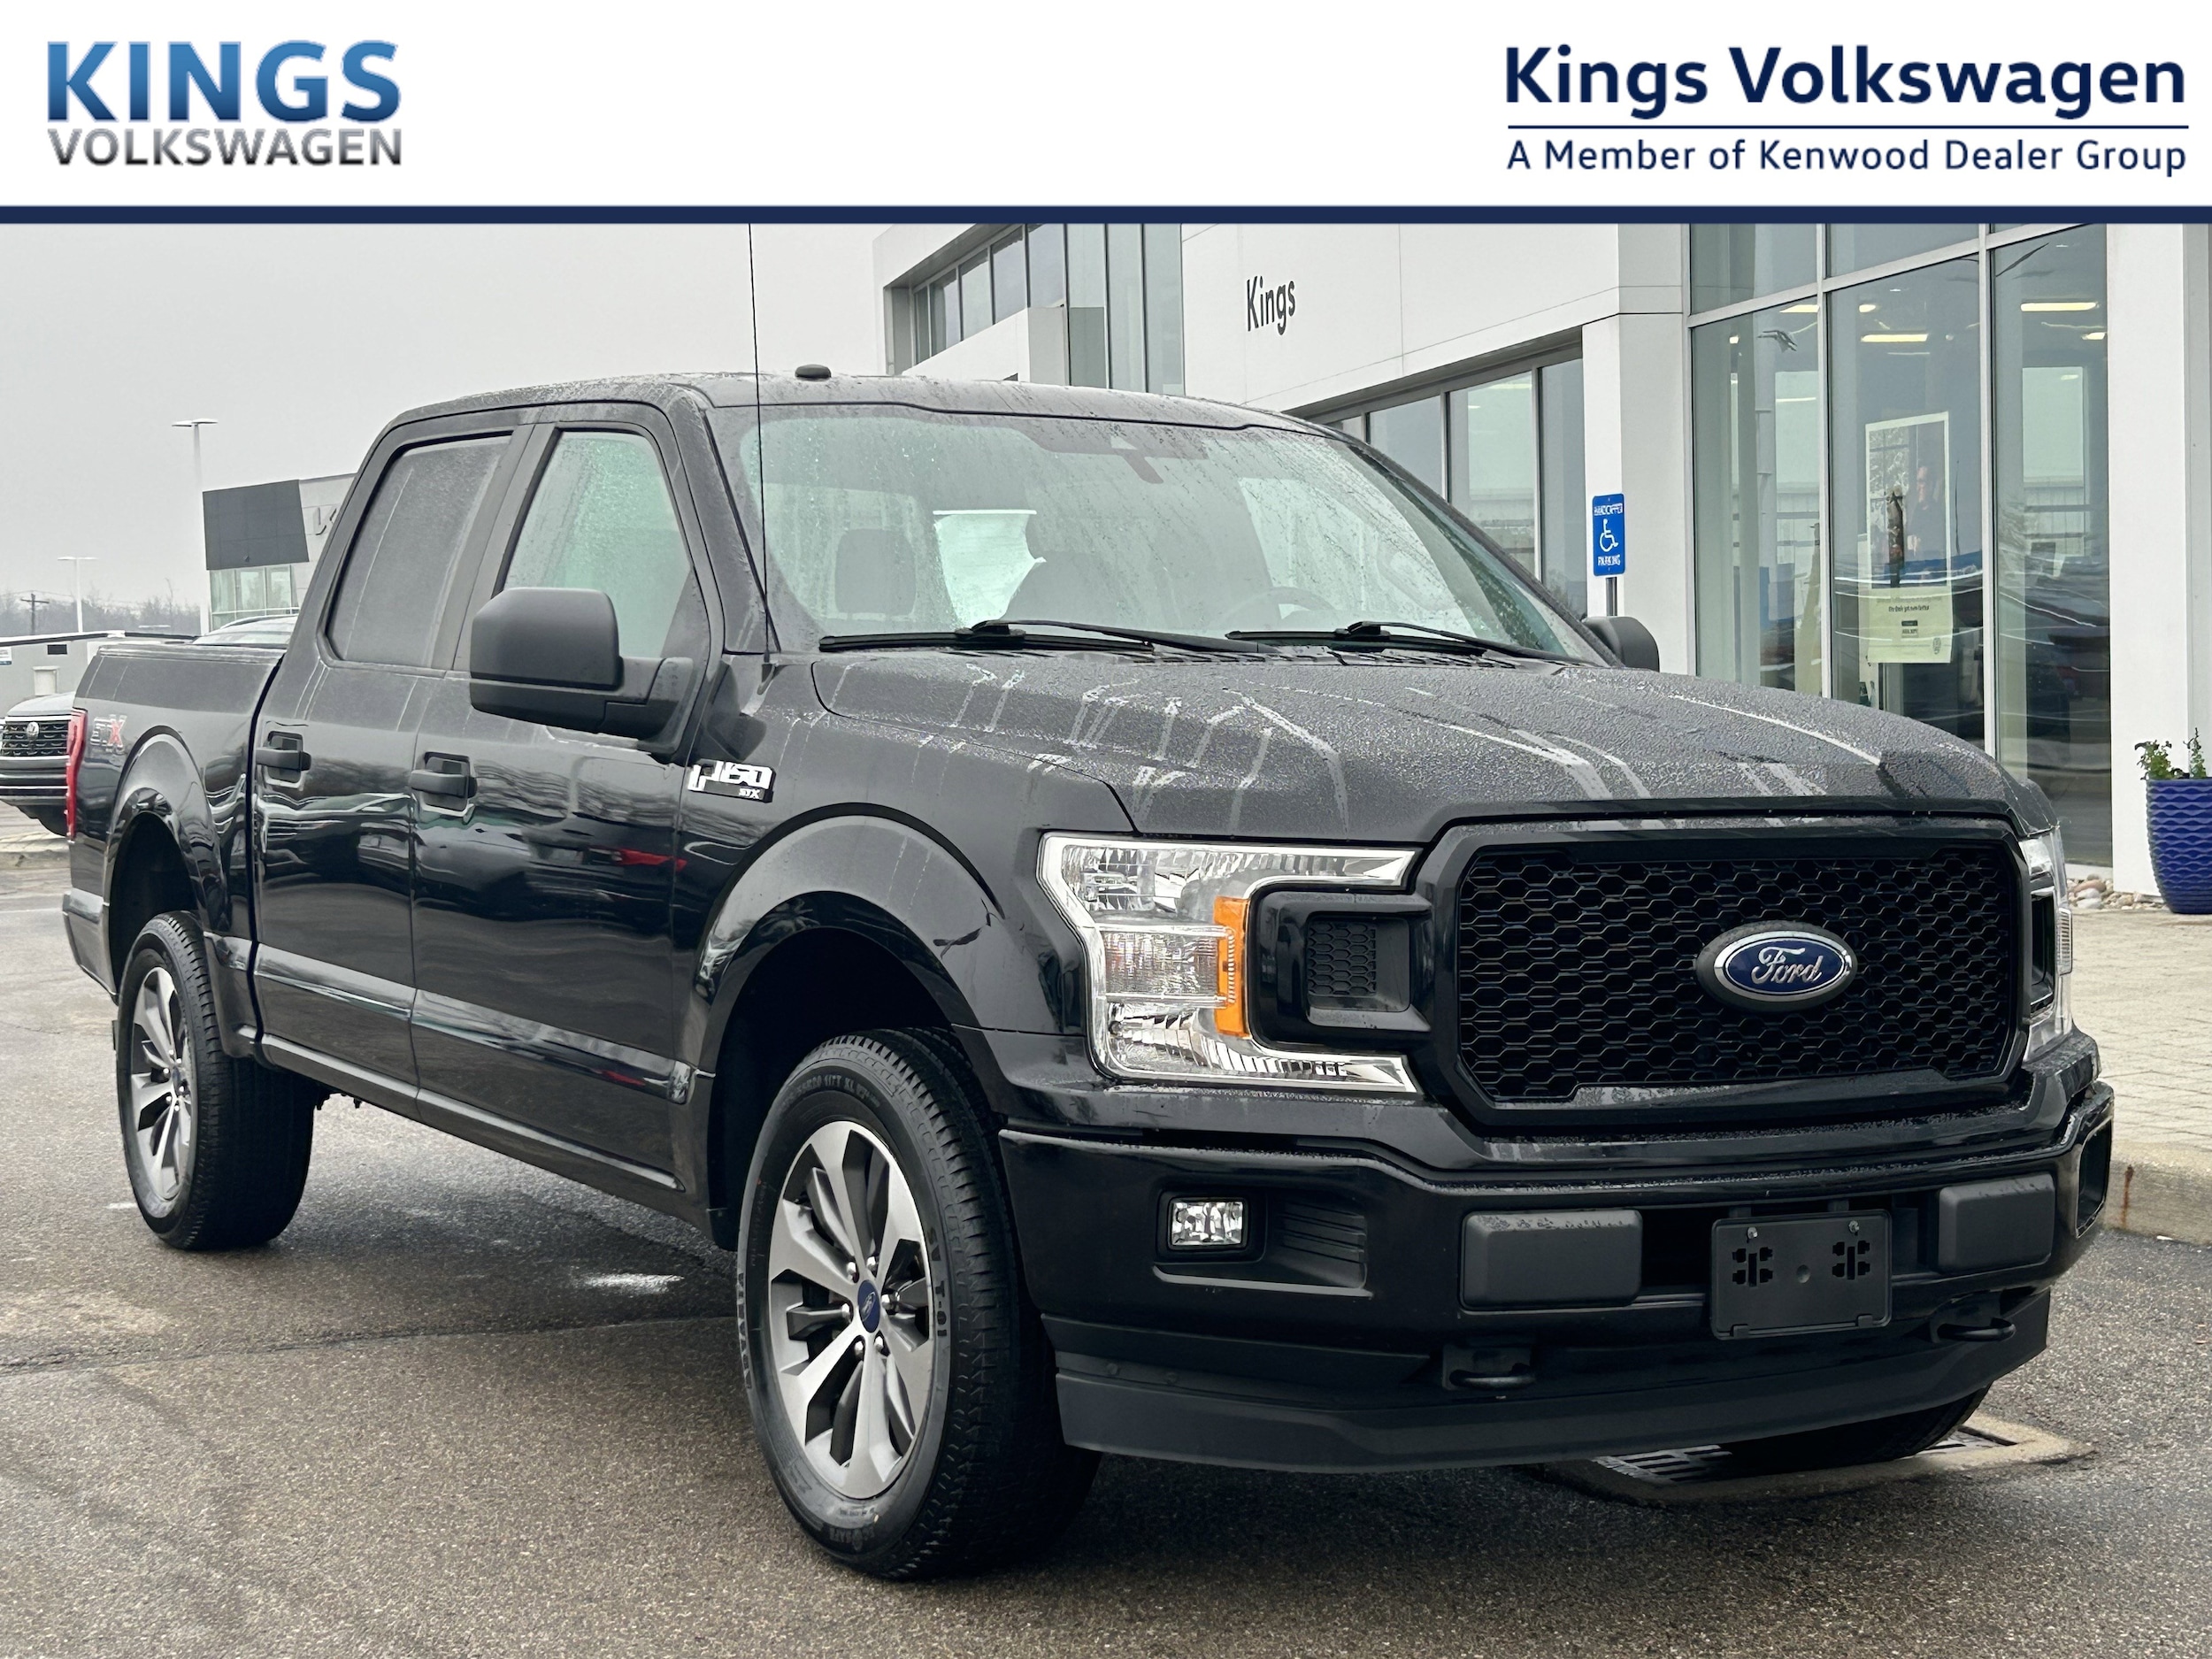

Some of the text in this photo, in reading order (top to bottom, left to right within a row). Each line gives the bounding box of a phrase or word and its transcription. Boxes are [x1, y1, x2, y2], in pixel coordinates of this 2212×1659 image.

[1247, 275, 1295, 335] Kings
[739, 788, 761, 800] STX
[1749, 946, 1824, 985] Ford
